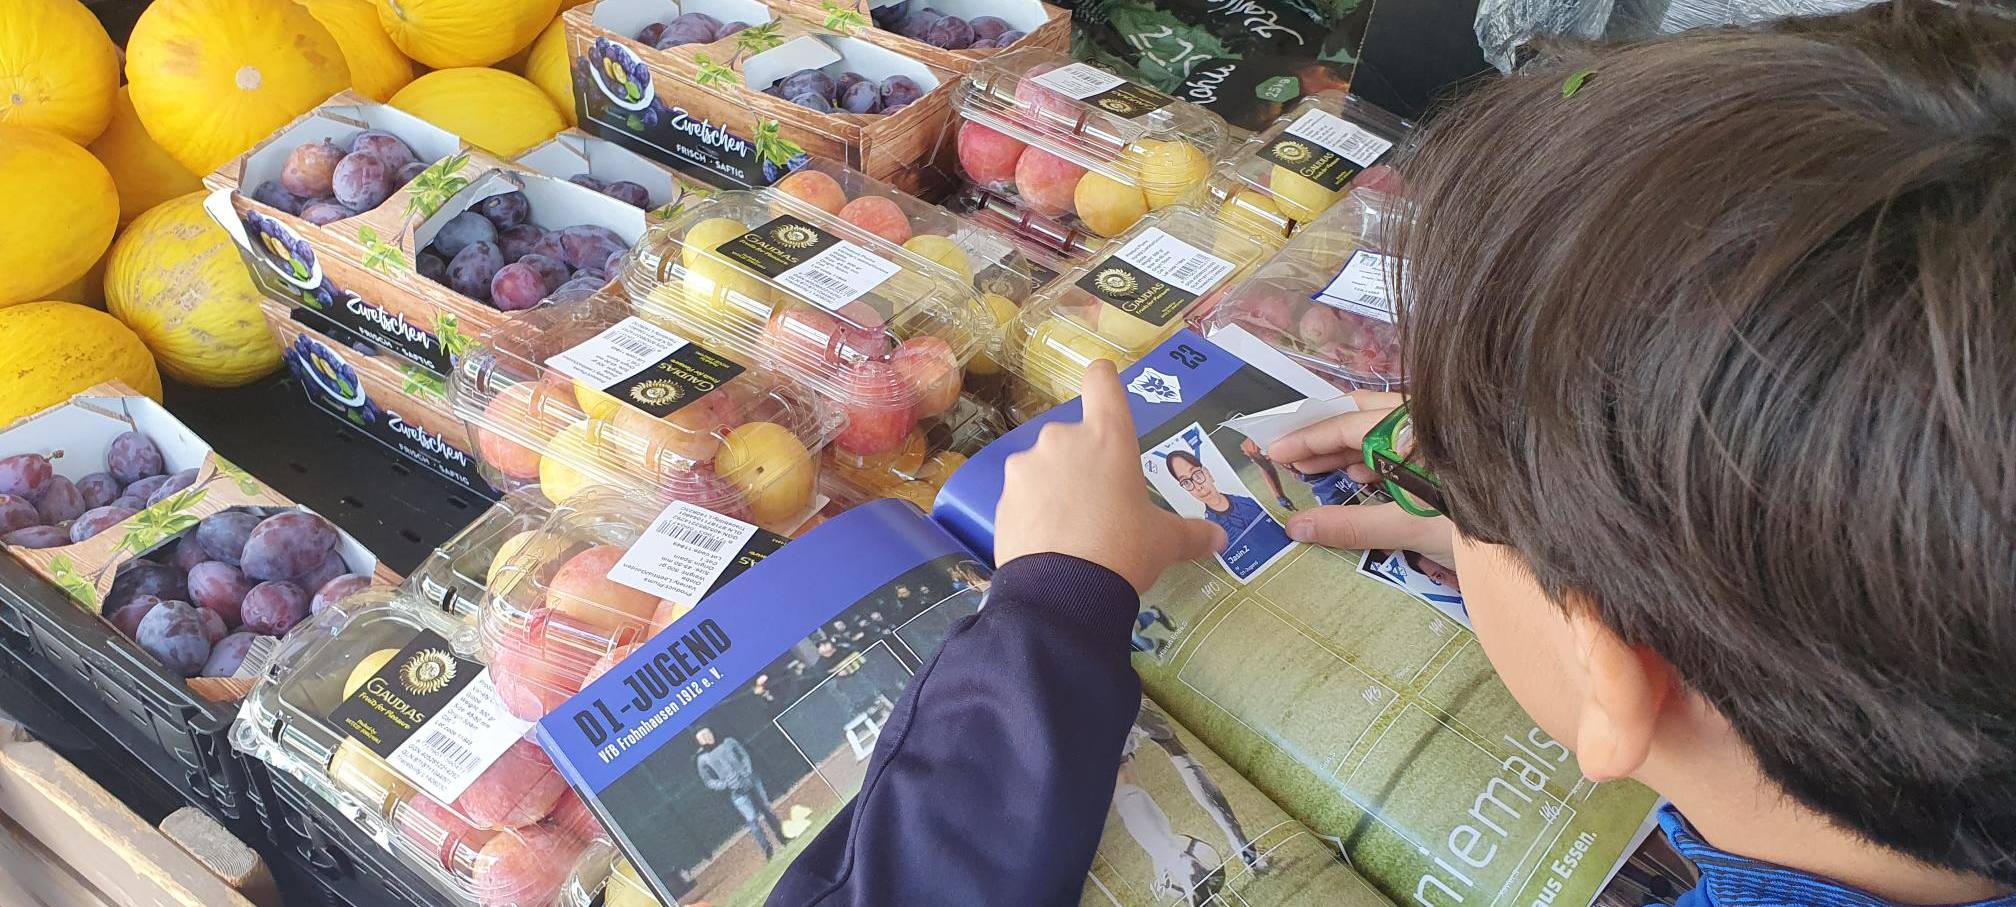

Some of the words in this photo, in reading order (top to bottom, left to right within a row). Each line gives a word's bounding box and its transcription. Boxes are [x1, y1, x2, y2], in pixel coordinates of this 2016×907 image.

[671, 107, 744, 157] Zwetschen
[674, 143, 707, 163] FRISCH
[713, 158, 746, 180] SAFTIG
[1297, 149, 1335, 179] GAUDIAS
[741, 232, 804, 263] GAUDIAS
[1119, 280, 1166, 313] GAUDIAS
[345, 291, 427, 348] Zwetschen
[653, 361, 717, 392] GAUDIAS
[1170, 344, 1207, 369] 23
[387, 410, 464, 466] Zwetschen
[1200, 580, 1220, 599] 140
[363, 674, 428, 725] GAUDIAS
[573, 615, 734, 747] D1-JUGEND
[597, 742, 620, 764] VfB
[616, 698, 680, 751] Frohnhausen
[675, 680, 703, 705] 1912
[700, 674, 714, 688] e.
[709, 664, 724, 680] V.
[1412, 726, 1571, 905] niemals
[1536, 798, 1563, 825] 146
[1550, 828, 1597, 879] Essen.
